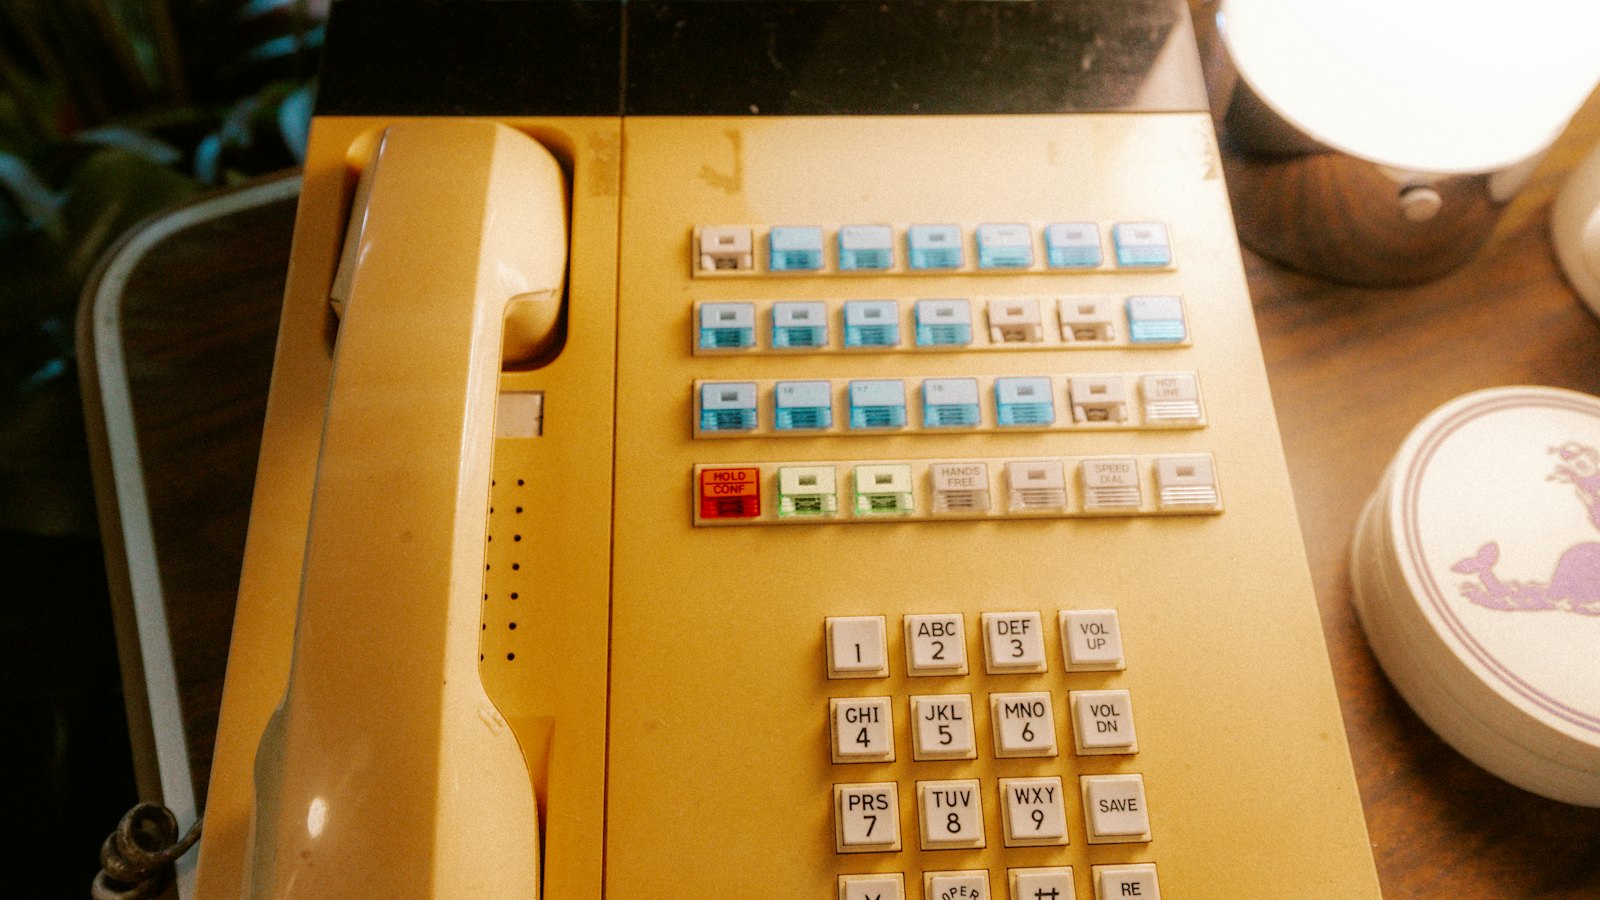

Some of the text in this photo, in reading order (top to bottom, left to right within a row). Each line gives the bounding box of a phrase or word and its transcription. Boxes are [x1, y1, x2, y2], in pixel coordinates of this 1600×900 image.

[1156, 378, 1178, 387] HOT
[713, 471, 746, 481] HOLD
[941, 466, 980, 476] HANDS
[1094, 463, 1129, 474] SPEED
[947, 477, 975, 487] FREE
[1100, 474, 1125, 484] DIAL
[713, 485, 746, 494] CONF
[917, 622, 956, 637] ABC
[997, 619, 1031, 635] DEF
[1080, 623, 1109, 635] VOL
[931, 641, 945, 660] 2
[1010, 639, 1024, 658] 3
[1087, 638, 1106, 650] UP
[855, 644, 862, 662] 1
[845, 707, 879, 723] GHI
[925, 705, 962, 721] JKL
[1005, 702, 1045, 719] MNO
[1090, 704, 1120, 717] VOL
[1021, 722, 1035, 742] 6
[1097, 720, 1118, 733] DN
[855, 727, 871, 748] 4
[939, 725, 953, 745] 5
[848, 794, 889, 811] PRS
[932, 790, 971, 807] TUV
[1014, 787, 1055, 805] WXY
[1099, 798, 1138, 813] SAVE
[863, 815, 877, 838] 7
[946, 812, 961, 834] 8
[1031, 809, 1044, 830] 9
[1120, 882, 1141, 896] RE
